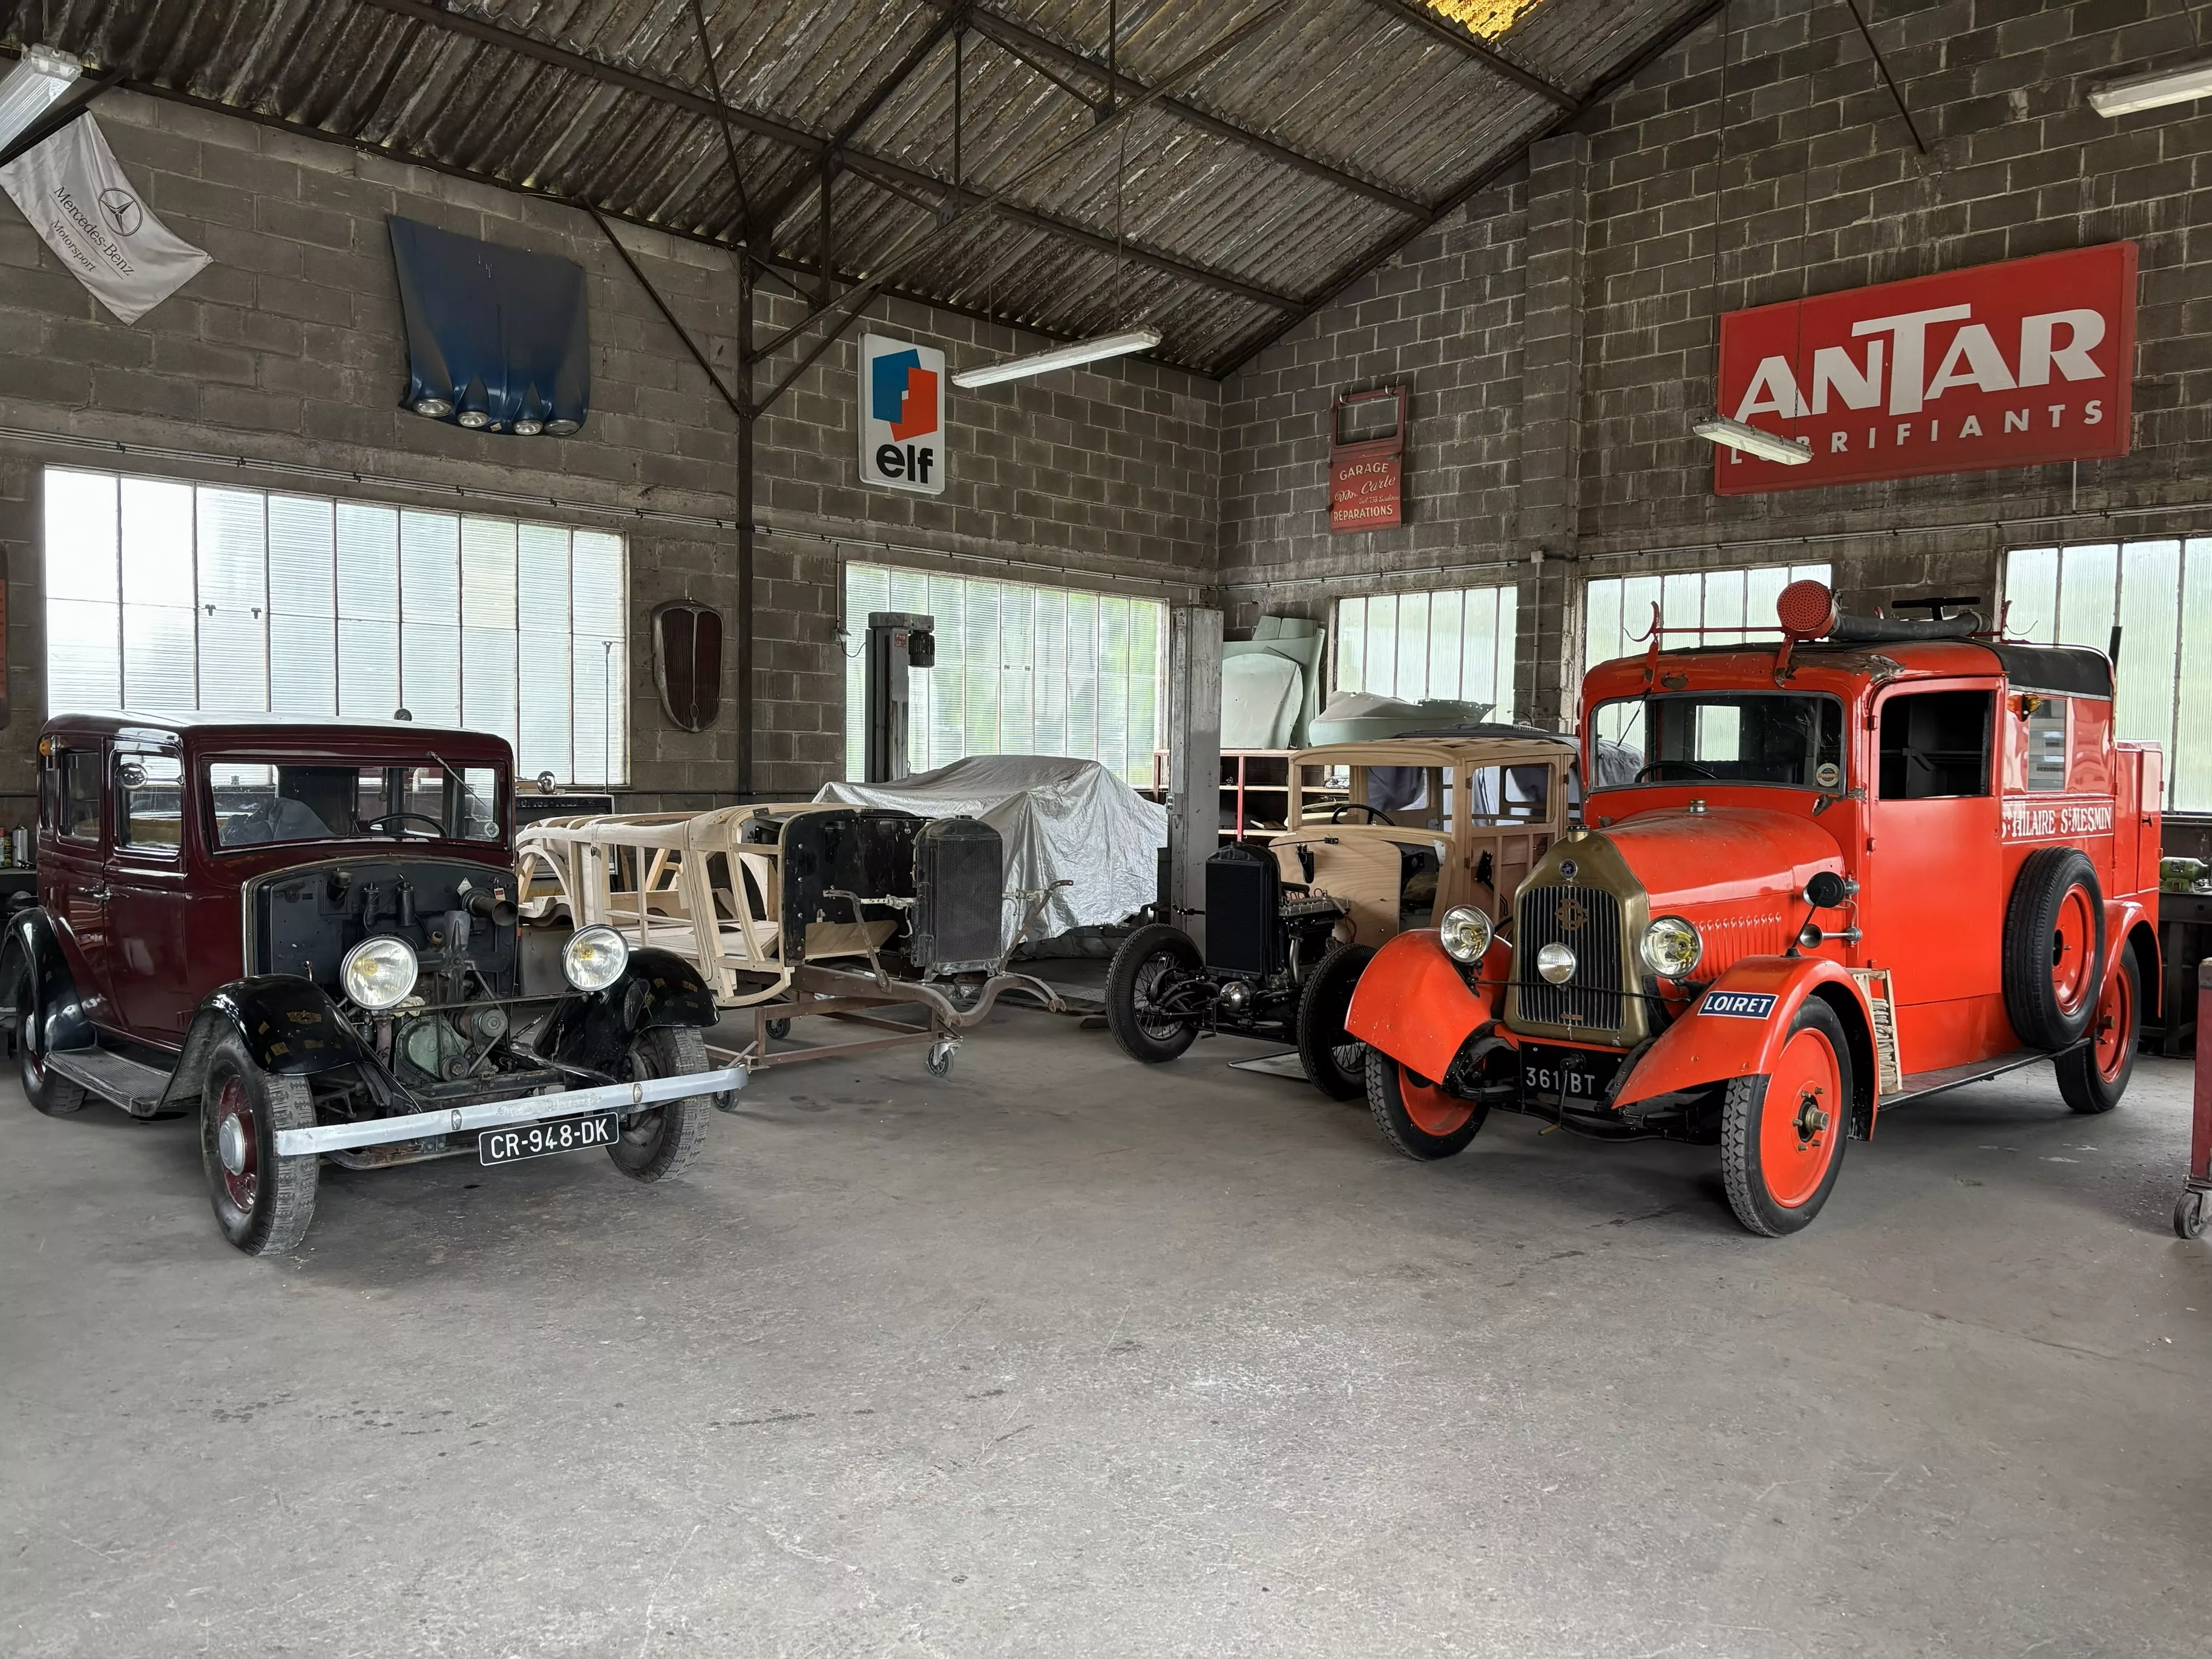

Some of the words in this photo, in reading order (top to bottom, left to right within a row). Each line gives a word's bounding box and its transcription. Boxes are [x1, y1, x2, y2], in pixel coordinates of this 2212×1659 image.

[51, 220, 96, 272] Motorsport
[54, 186, 134, 275] Mercedes-Benz
[1733, 303, 2106, 423] ANTAR
[1731, 399, 2102, 464] LRIFIANTS
[876, 444, 933, 484] elf
[1339, 462, 1389, 481] GARAGE
[1361, 475, 1396, 494] Carle
[1333, 504, 1393, 522] RÉPARATIONS
[2012, 809, 2056, 838] HILAIRE
[1704, 996, 1771, 1013] LOIRET
[1526, 1066, 1559, 1090] 361
[1570, 1073, 1595, 1095] BT
[491, 1118, 609, 1159] CR-948-DK
